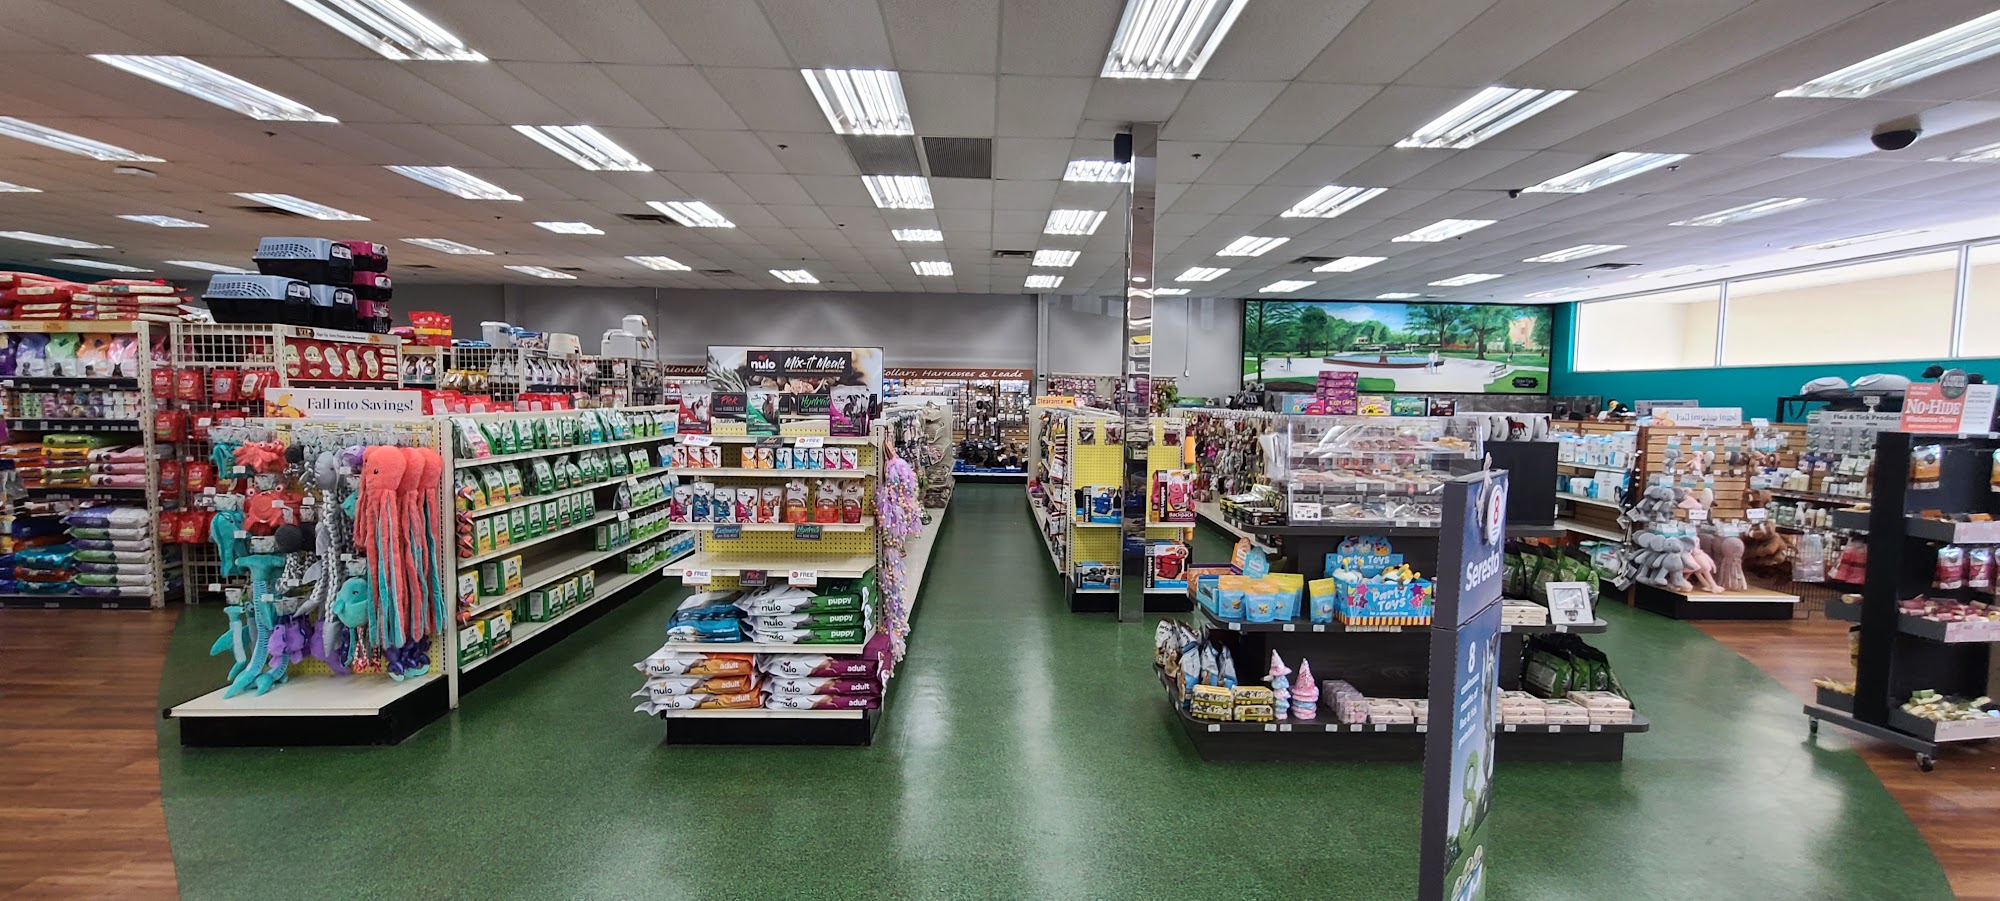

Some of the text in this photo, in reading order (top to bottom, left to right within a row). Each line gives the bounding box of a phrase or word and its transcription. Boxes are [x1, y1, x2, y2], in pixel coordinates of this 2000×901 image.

[751, 358, 776, 369] nulo
[816, 356, 845, 370] Meals
[720, 395, 738, 405] Pick
[801, 395, 830, 406] Hydrat
[307, 398, 413, 413] Fall into Savings!
[1677, 413, 1689, 421] Fall
[1493, 495, 1500, 525] 8
[1337, 555, 1390, 566] Prty Toys
[1465, 550, 1499, 591] Seresto
[1372, 585, 1408, 601] Party
[828, 597, 852, 606] puppy
[1378, 598, 1406, 611] Toys
[829, 614, 853, 622] puppy
[831, 630, 855, 638] puppy
[1468, 641, 1476, 673] 8
[651, 664, 671, 672] nulo
[720, 661, 739, 670] adult
[847, 664, 867, 672] adult
[721, 680, 740, 689] adult
[782, 685, 801, 693] nulo
[851, 683, 870, 691] adult
[731, 694, 751, 702] adult
[848, 698, 867, 706] adult
